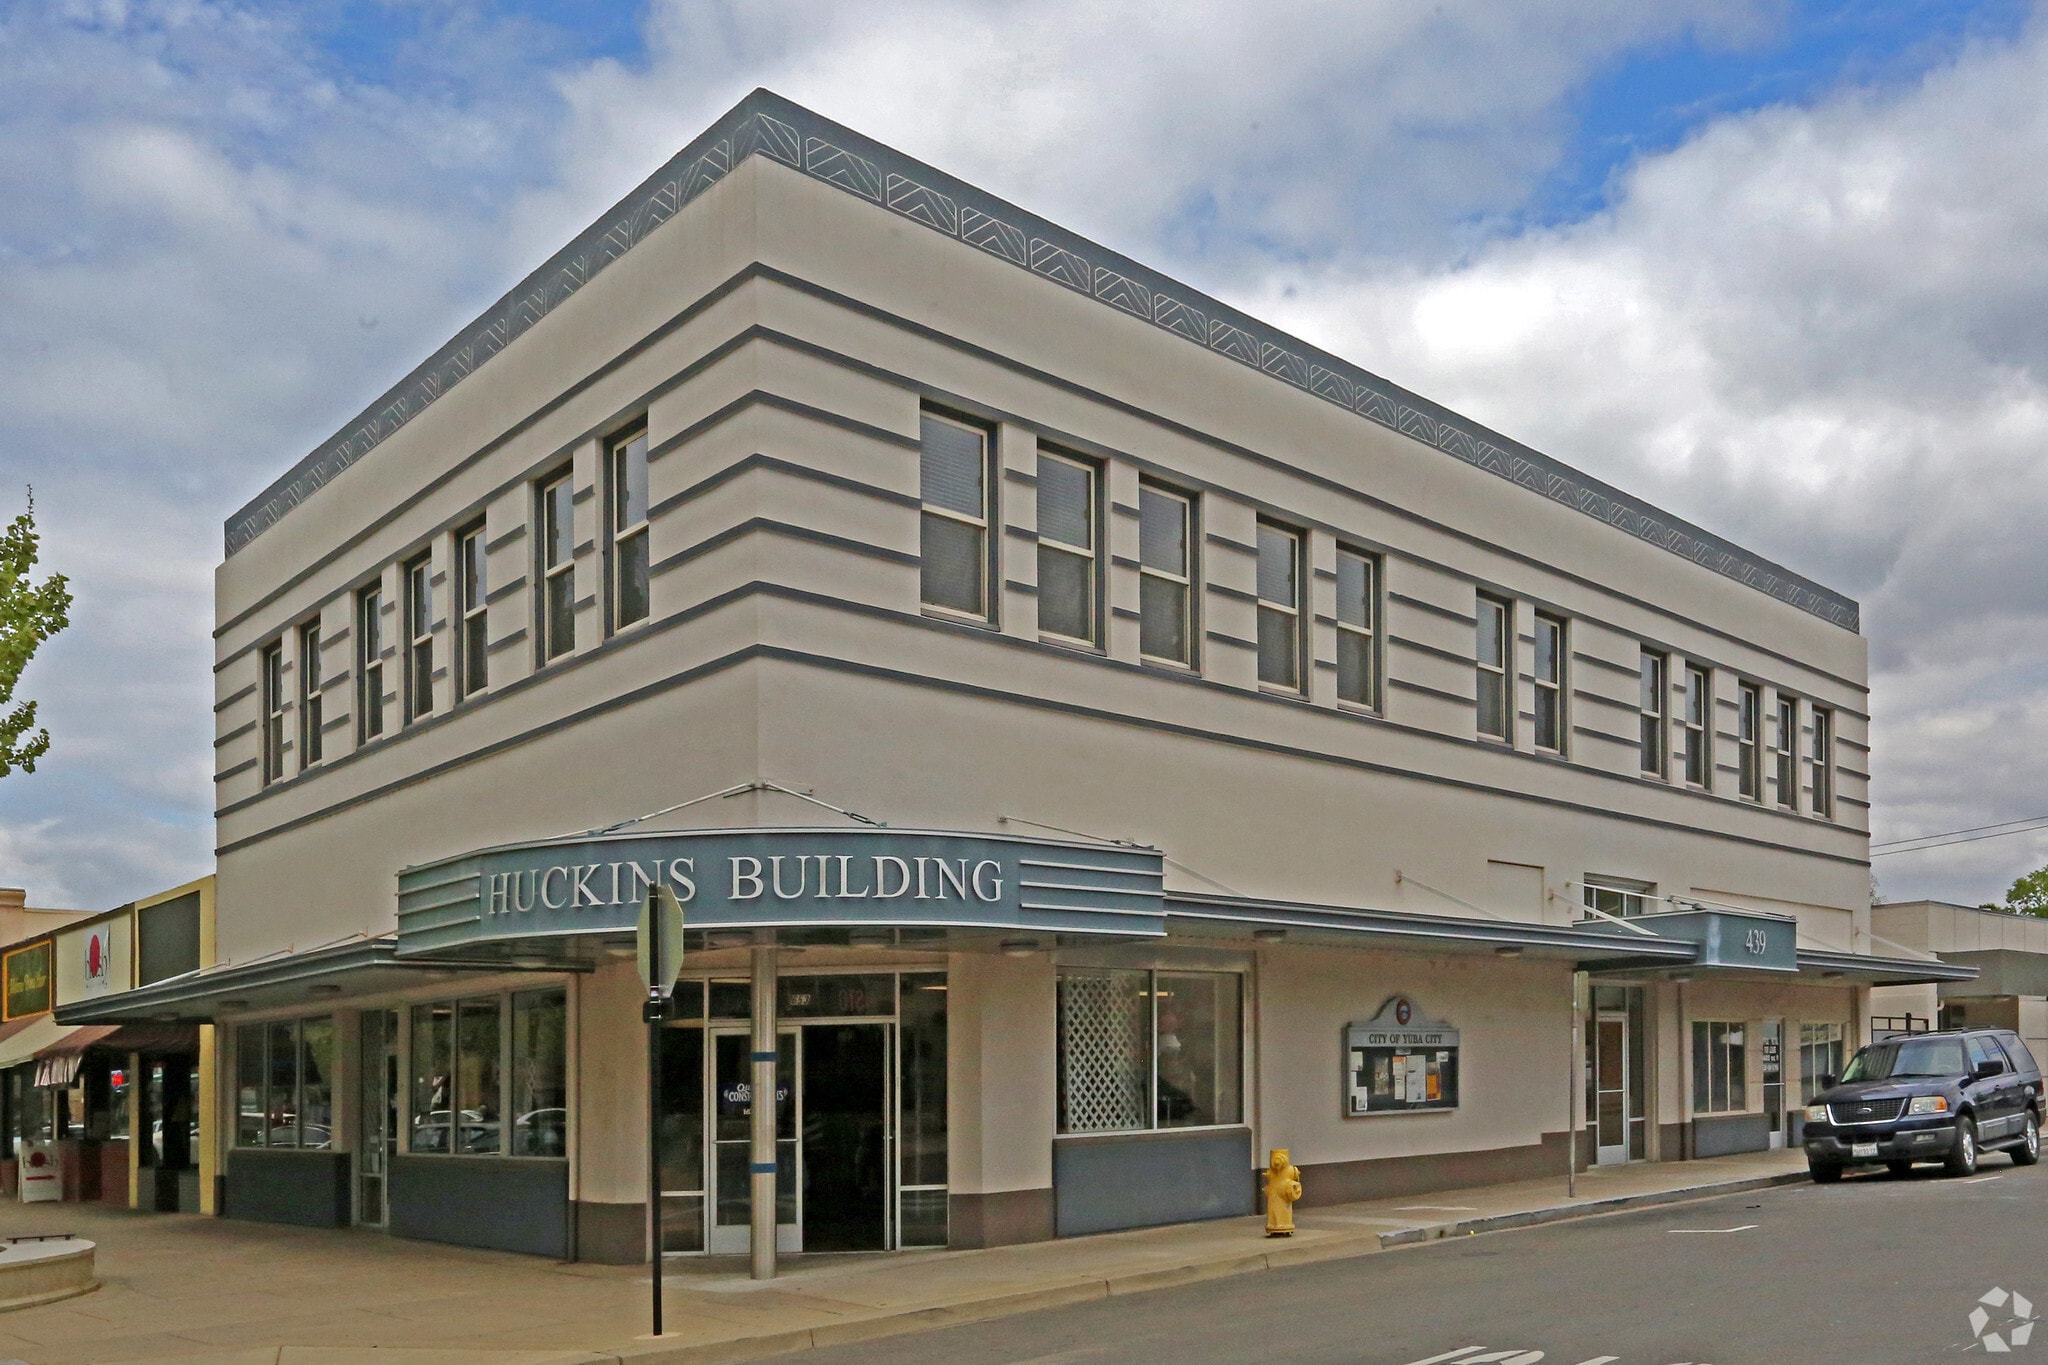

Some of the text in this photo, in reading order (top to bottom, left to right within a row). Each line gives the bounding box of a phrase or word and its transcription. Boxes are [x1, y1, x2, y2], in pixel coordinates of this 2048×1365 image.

[488, 855, 1004, 914] HUCKINS BUILDING
[1746, 929, 1766, 955] 439
[1368, 1033, 1443, 1044] CITY OF YUBA CITY
